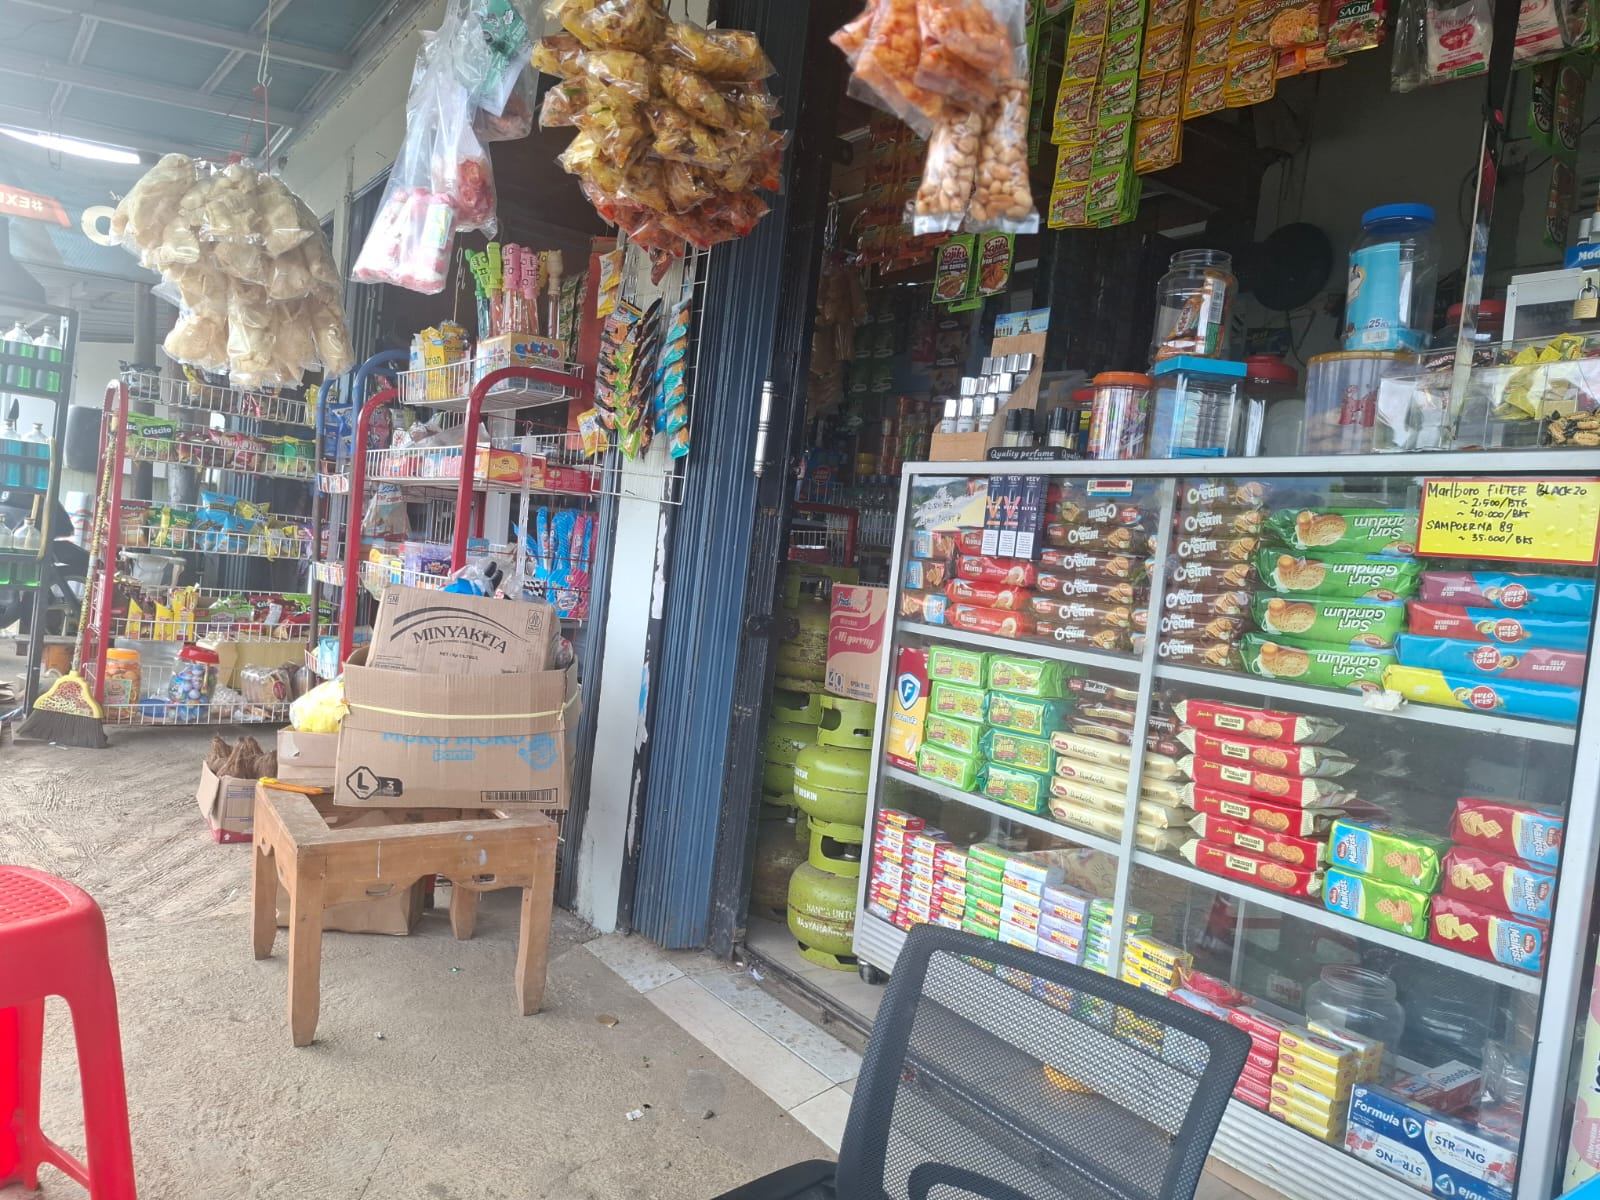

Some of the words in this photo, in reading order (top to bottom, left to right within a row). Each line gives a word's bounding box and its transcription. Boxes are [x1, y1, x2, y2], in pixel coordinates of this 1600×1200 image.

[1340, 2, 1371, 18] SAORI
[991, 449, 1019, 460] Quality
[1020, 449, 1055, 459] perfume
[1187, 487, 1224, 504] Cream
[1427, 483, 1479, 498] Marlboro
[1488, 484, 1527, 497] FILTER
[1088, 504, 1117, 519] Cream
[1184, 514, 1222, 531] Cream
[1068, 529, 1099, 544] Cream
[1368, 527, 1404, 540] Sari
[1178, 541, 1217, 557] Cream
[964, 563, 983, 573] Roma
[1063, 557, 1096, 569] Cream
[1173, 566, 1212, 581] Cream
[1333, 564, 1398, 578] Gandum
[1062, 581, 1098, 595] Cream
[1348, 575, 1383, 587] Sari
[1165, 593, 1203, 608] Cream
[1058, 605, 1095, 619] Cream
[1323, 607, 1386, 623] Gandum
[1161, 617, 1194, 632] Cream
[1337, 619, 1372, 632] Sari
[413, 626, 507, 654] MINYAKITA
[1054, 626, 1085, 640] Cream
[1158, 642, 1194, 657] Cream
[1316, 653, 1380, 668] Gandum
[1333, 665, 1366, 679] Sari
[357, 772, 370, 791] L
[1532, 822, 1548, 857] Malkist
[1348, 833, 1358, 864] Malkist
[1339, 880, 1350, 910] Malkist
[1523, 876, 1539, 913] Malkist
[832, 909, 856, 919] UNTU
[1509, 927, 1526, 962] Malkist
[1354, 1100, 1400, 1127] Formula
